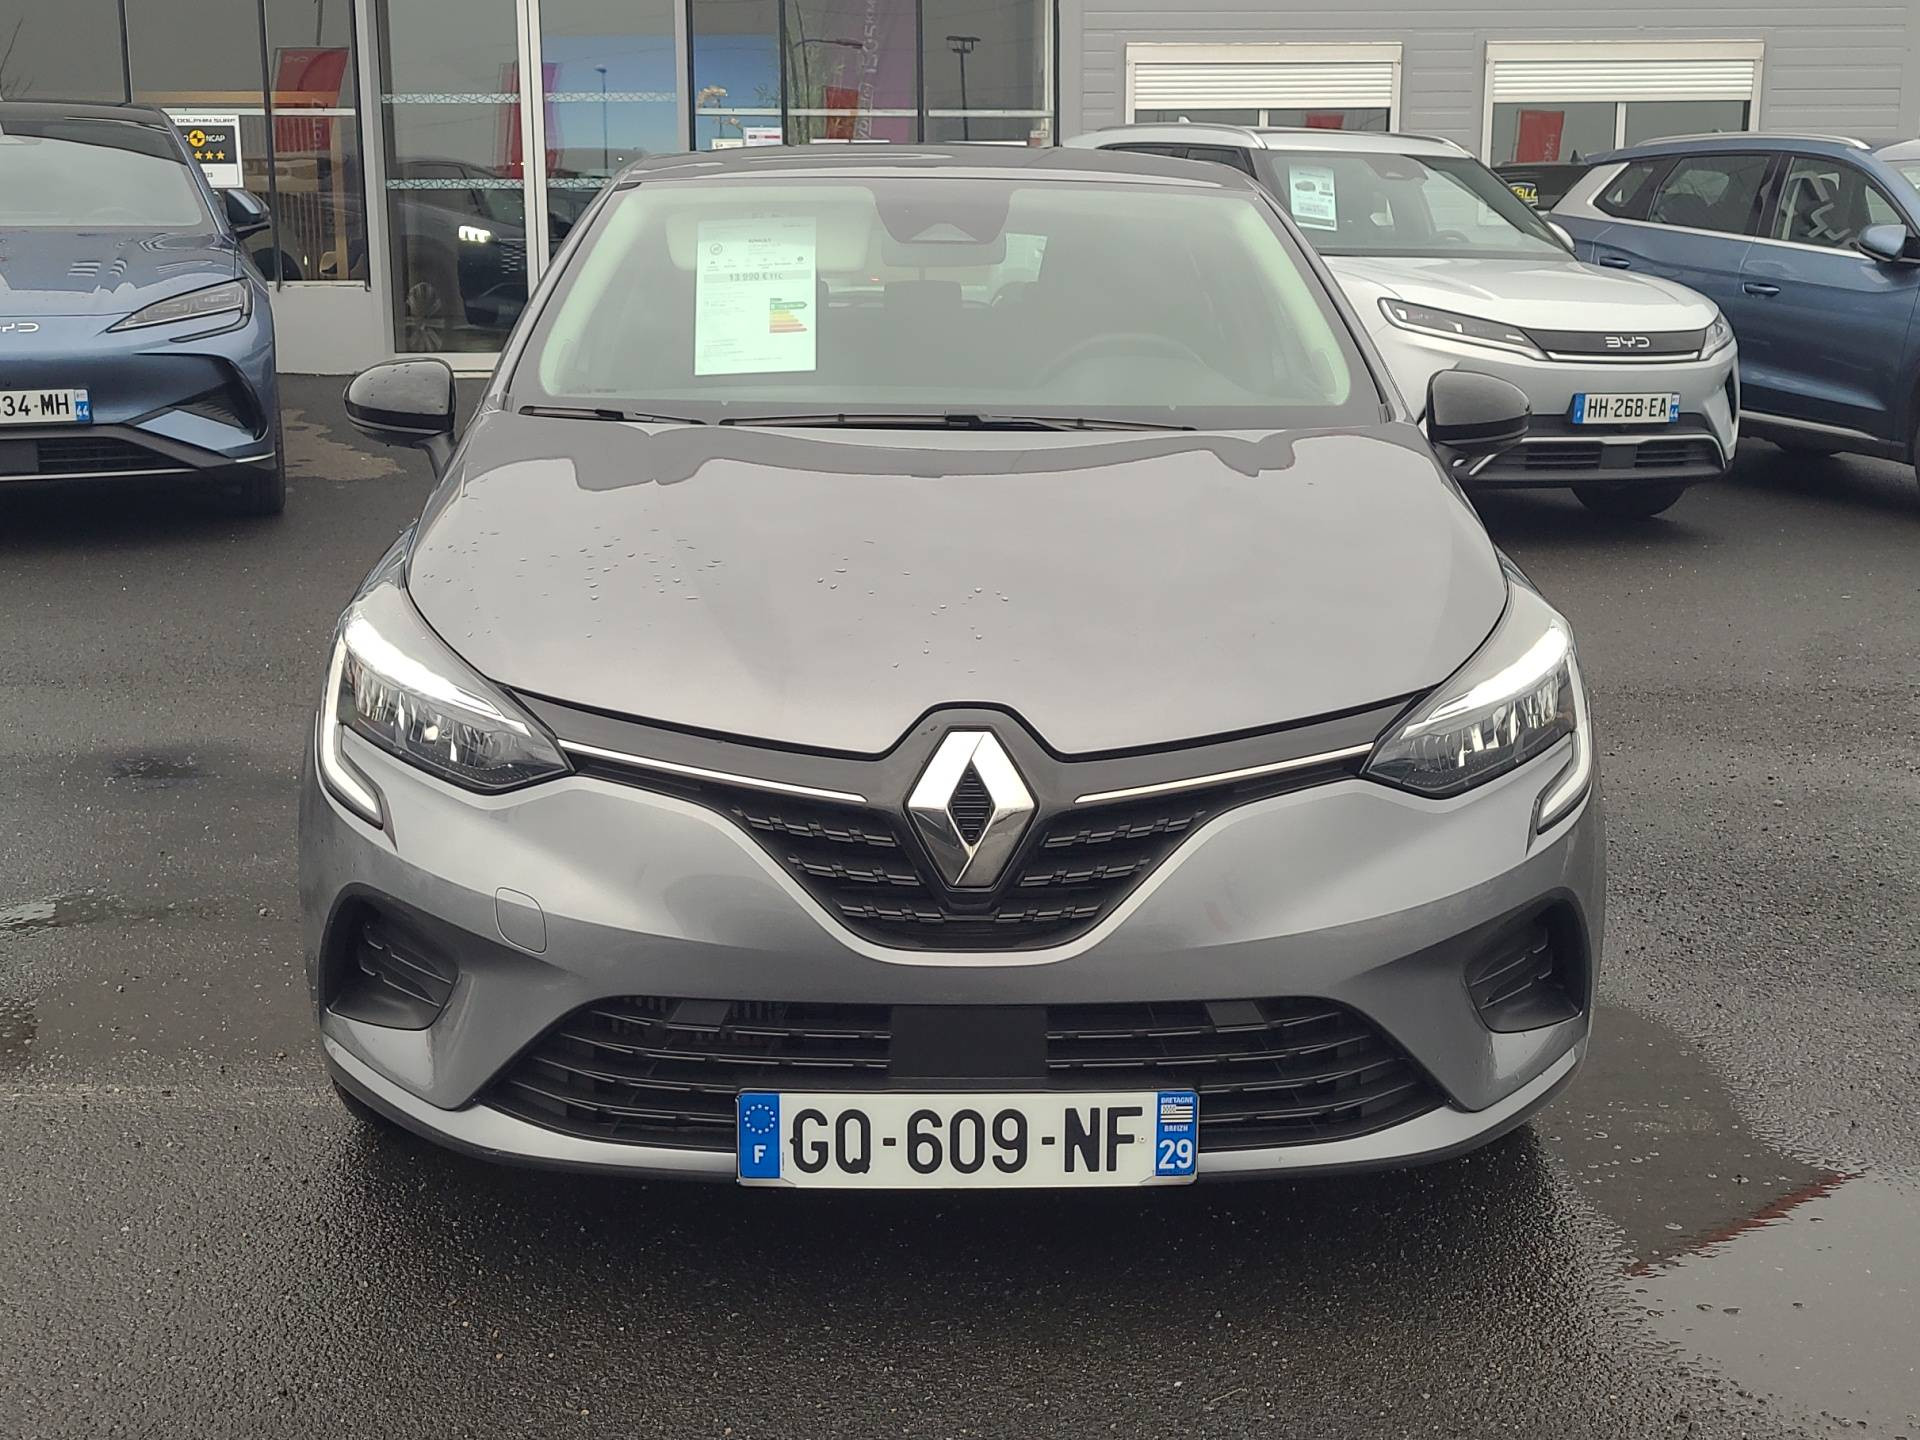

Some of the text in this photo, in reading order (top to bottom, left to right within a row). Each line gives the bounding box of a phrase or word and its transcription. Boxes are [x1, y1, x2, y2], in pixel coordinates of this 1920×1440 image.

[1605, 336, 1651, 348] BYD
[0, 393, 70, 416] 34-MH
[1587, 398, 1667, 418] HH-268-EA
[1160, 1096, 1194, 1104] BRETAGNE
[1163, 1124, 1189, 1132] BREIZH
[792, 1106, 1143, 1174] GQ-609-NF
[753, 1144, 767, 1164] F
[1158, 1138, 1193, 1170] 29
